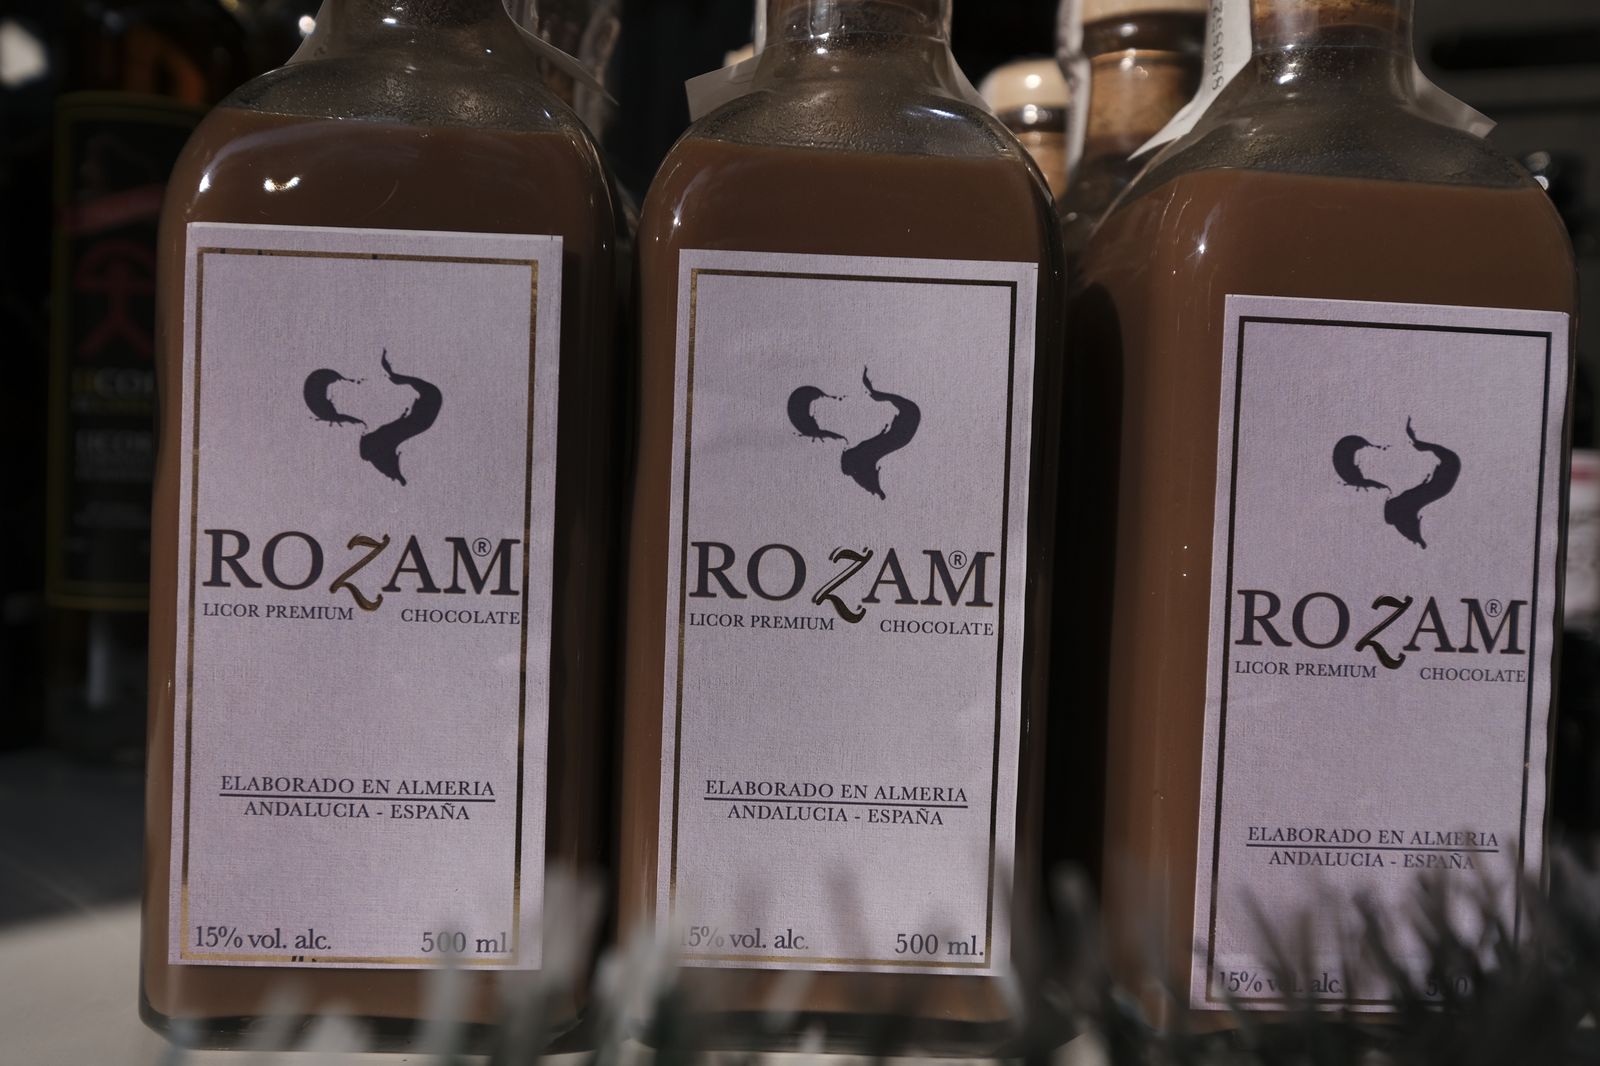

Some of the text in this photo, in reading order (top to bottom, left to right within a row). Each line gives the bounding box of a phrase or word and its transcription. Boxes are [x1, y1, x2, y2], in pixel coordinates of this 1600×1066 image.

[204, 602, 521, 626] LICOR PREMIUM CHOCOLATE
[689, 612, 994, 636] LICOR PREMIUM CHOCOLATE
[1235, 660, 1526, 683] LICOR PREMIUM CHOCOLATE
[220, 776, 495, 797] ELABORADO EN ALMERIA
[705, 780, 968, 803] ELABORADO EN ALMERIA
[243, 801, 371, 818] ANDALUCIA
[389, 802, 471, 820] ESPAÑA
[728, 804, 849, 822] ANDALUCIA
[867, 807, 944, 826] ESPAÑA
[1247, 827, 1498, 847] ELABORADO EN ALMERIA
[1268, 850, 1386, 868] ANDALUCIA
[1403, 852, 1476, 871] ESPAÑA
[195, 926, 332, 950] 15% vol. alc.
[420, 932, 467, 954] 500
[729, 928, 767, 949] vol.
[773, 929, 809, 950] alc.
[894, 934, 986, 957] 500 ml.
